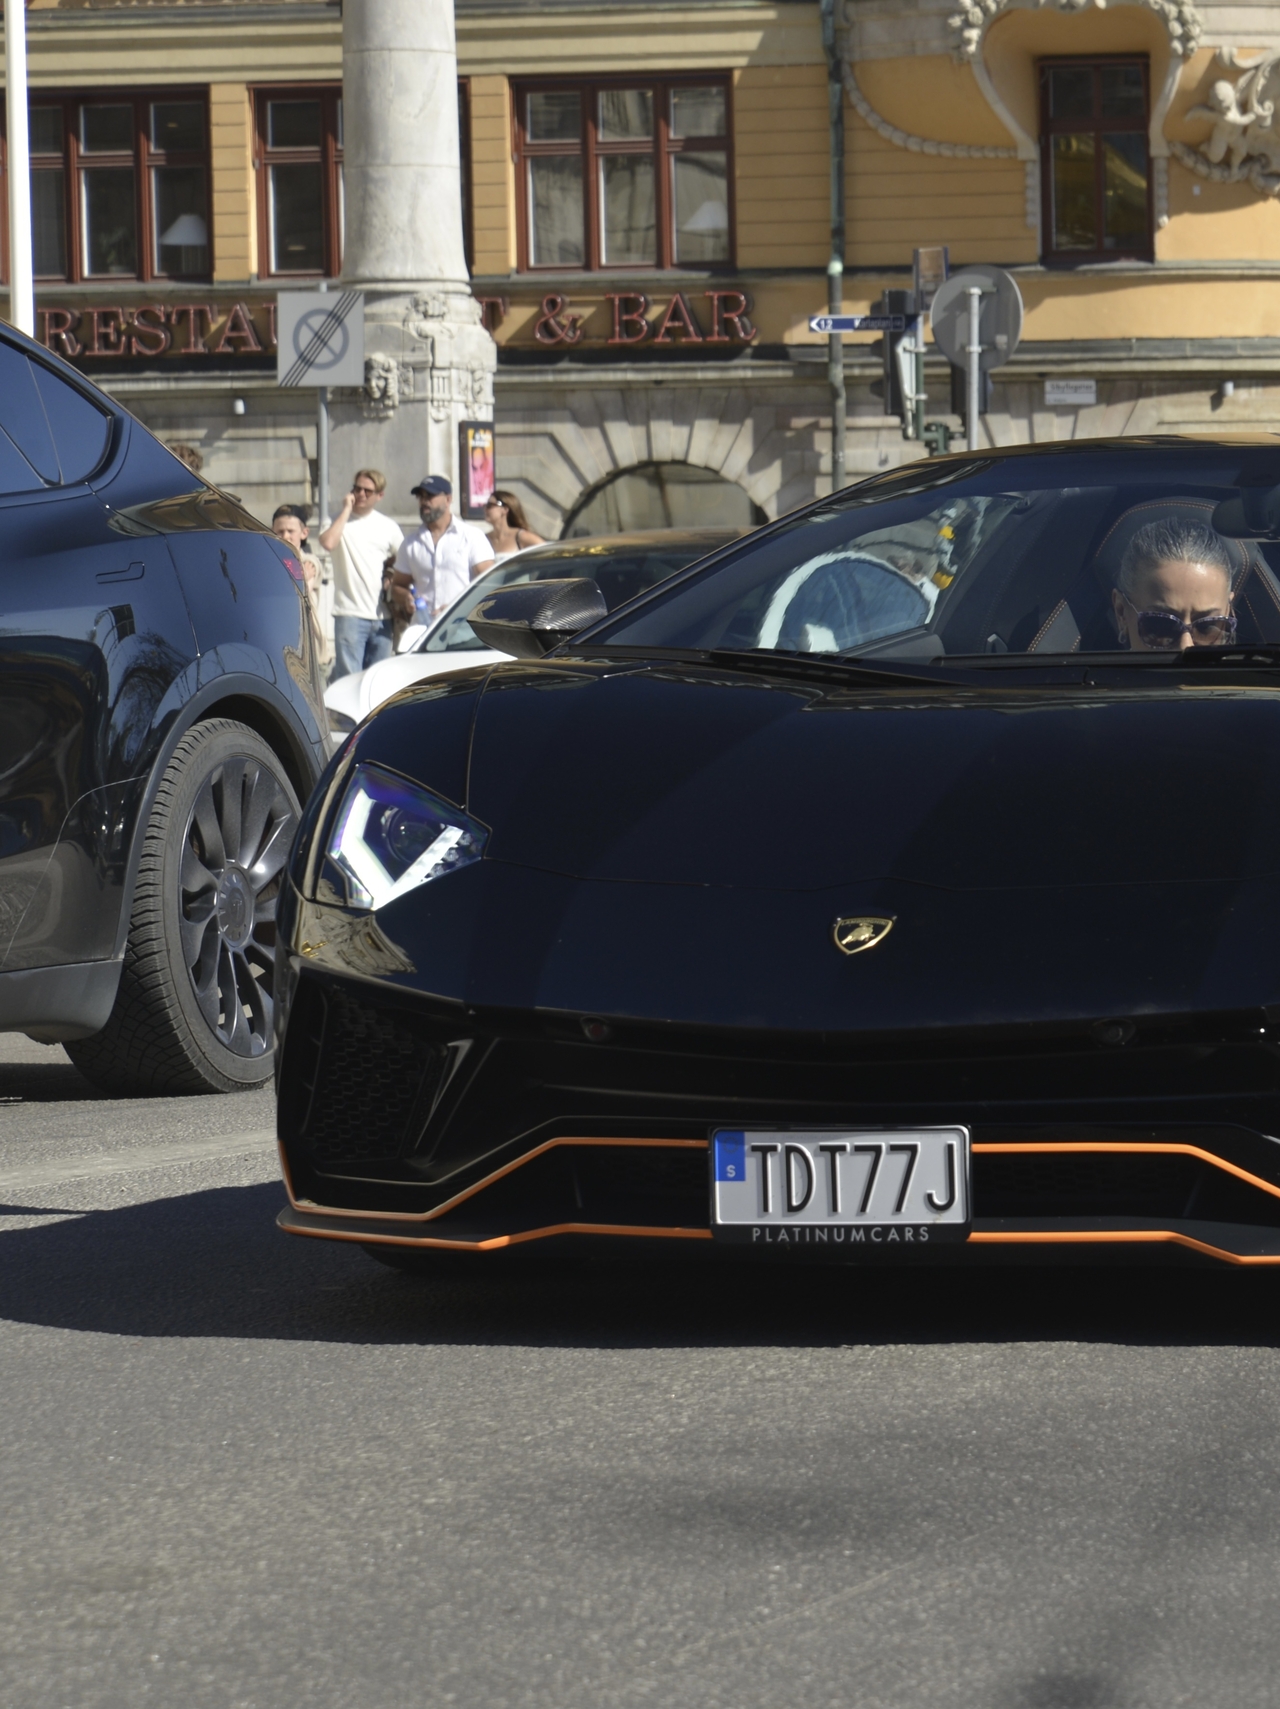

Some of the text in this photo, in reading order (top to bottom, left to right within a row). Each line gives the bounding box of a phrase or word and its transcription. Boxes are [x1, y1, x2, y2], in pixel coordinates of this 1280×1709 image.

[535, 293, 583, 343] &
[605, 290, 757, 344] BAR
[726, 1165, 736, 1178] S
[750, 1141, 958, 1214] TDT77J
[752, 1227, 930, 1243] PLATINUMCARS
